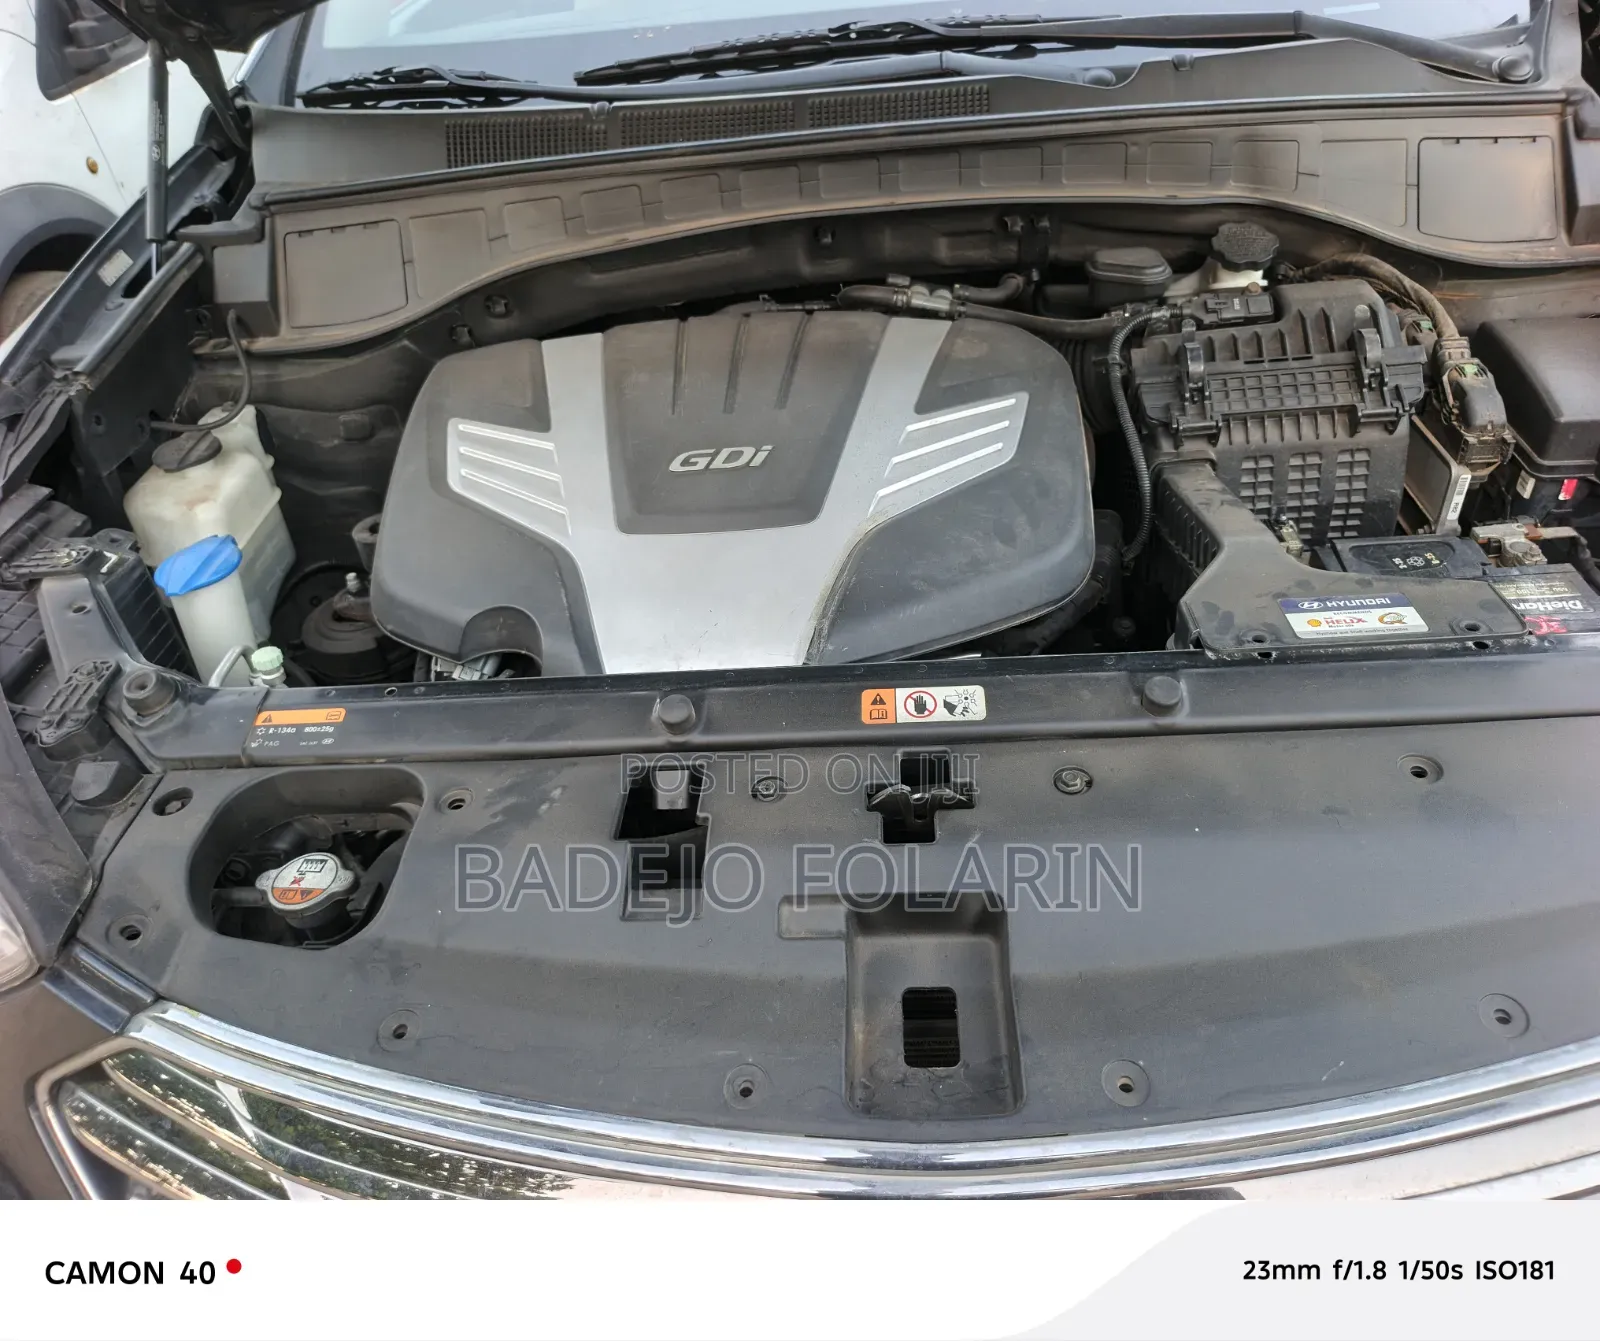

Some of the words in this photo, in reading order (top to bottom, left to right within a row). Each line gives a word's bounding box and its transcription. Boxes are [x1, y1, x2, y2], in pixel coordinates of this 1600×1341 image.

[668, 445, 775, 472] GDi
[1326, 597, 1391, 607] HYUNDAI
[1512, 600, 1583, 611] DieHar
[1325, 617, 1368, 625] HELIX
